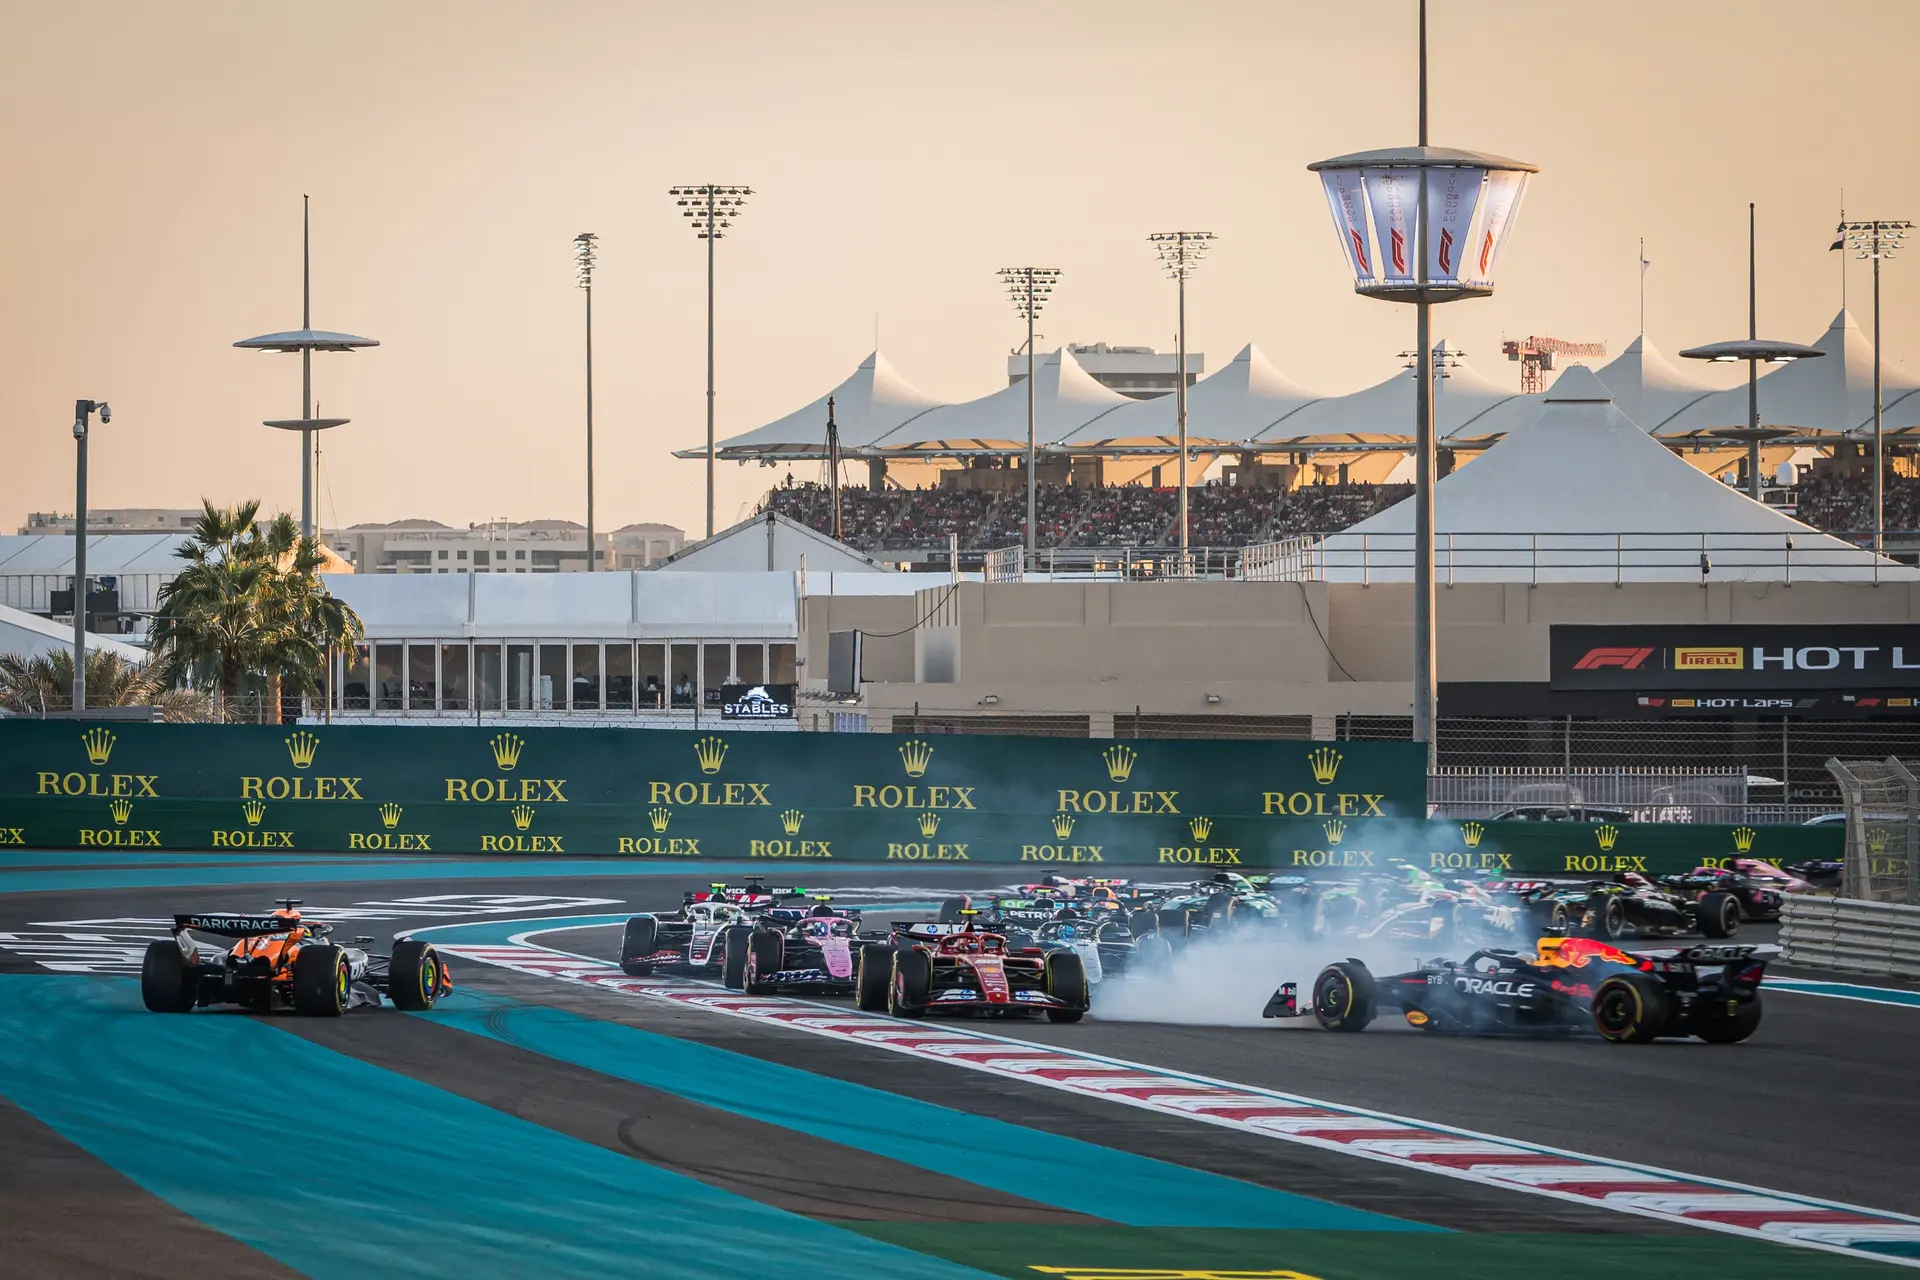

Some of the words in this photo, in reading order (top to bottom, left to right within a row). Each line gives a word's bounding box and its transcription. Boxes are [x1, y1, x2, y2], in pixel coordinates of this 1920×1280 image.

[1443, 172, 1457, 222] PADDOCK
[1450, 193, 1460, 222] CLUB
[1680, 651, 1738, 666] PIRELLI
[1753, 646, 1880, 670] HOT
[724, 703, 789, 714] STABLES
[1696, 699, 1740, 708] HOT
[37, 772, 160, 798] ROLEX
[240, 775, 364, 800] ROLEX
[445, 778, 569, 802] ROLEX
[648, 781, 772, 806] ROLEX
[853, 784, 977, 810] ROLEX
[1057, 789, 1181, 814] ROLEX
[1262, 791, 1386, 817] ROLEX
[79, 829, 162, 846] ROLEX
[212, 831, 295, 848] ROLEX
[349, 833, 432, 850] ROLEX
[481, 835, 565, 853] ROLEX
[618, 837, 700, 855] ROLEX
[750, 840, 832, 858] ROLEX
[887, 842, 970, 860] ROLEX
[1021, 845, 1104, 862] ROLEX
[1158, 847, 1242, 864] ROLEX
[1292, 849, 1375, 867] ROLEX
[1429, 852, 1513, 869] ROLEX
[1565, 855, 1648, 872] ROLEX
[190, 917, 279, 931] DARKTRACE
[1454, 977, 1536, 997] ORACLE
